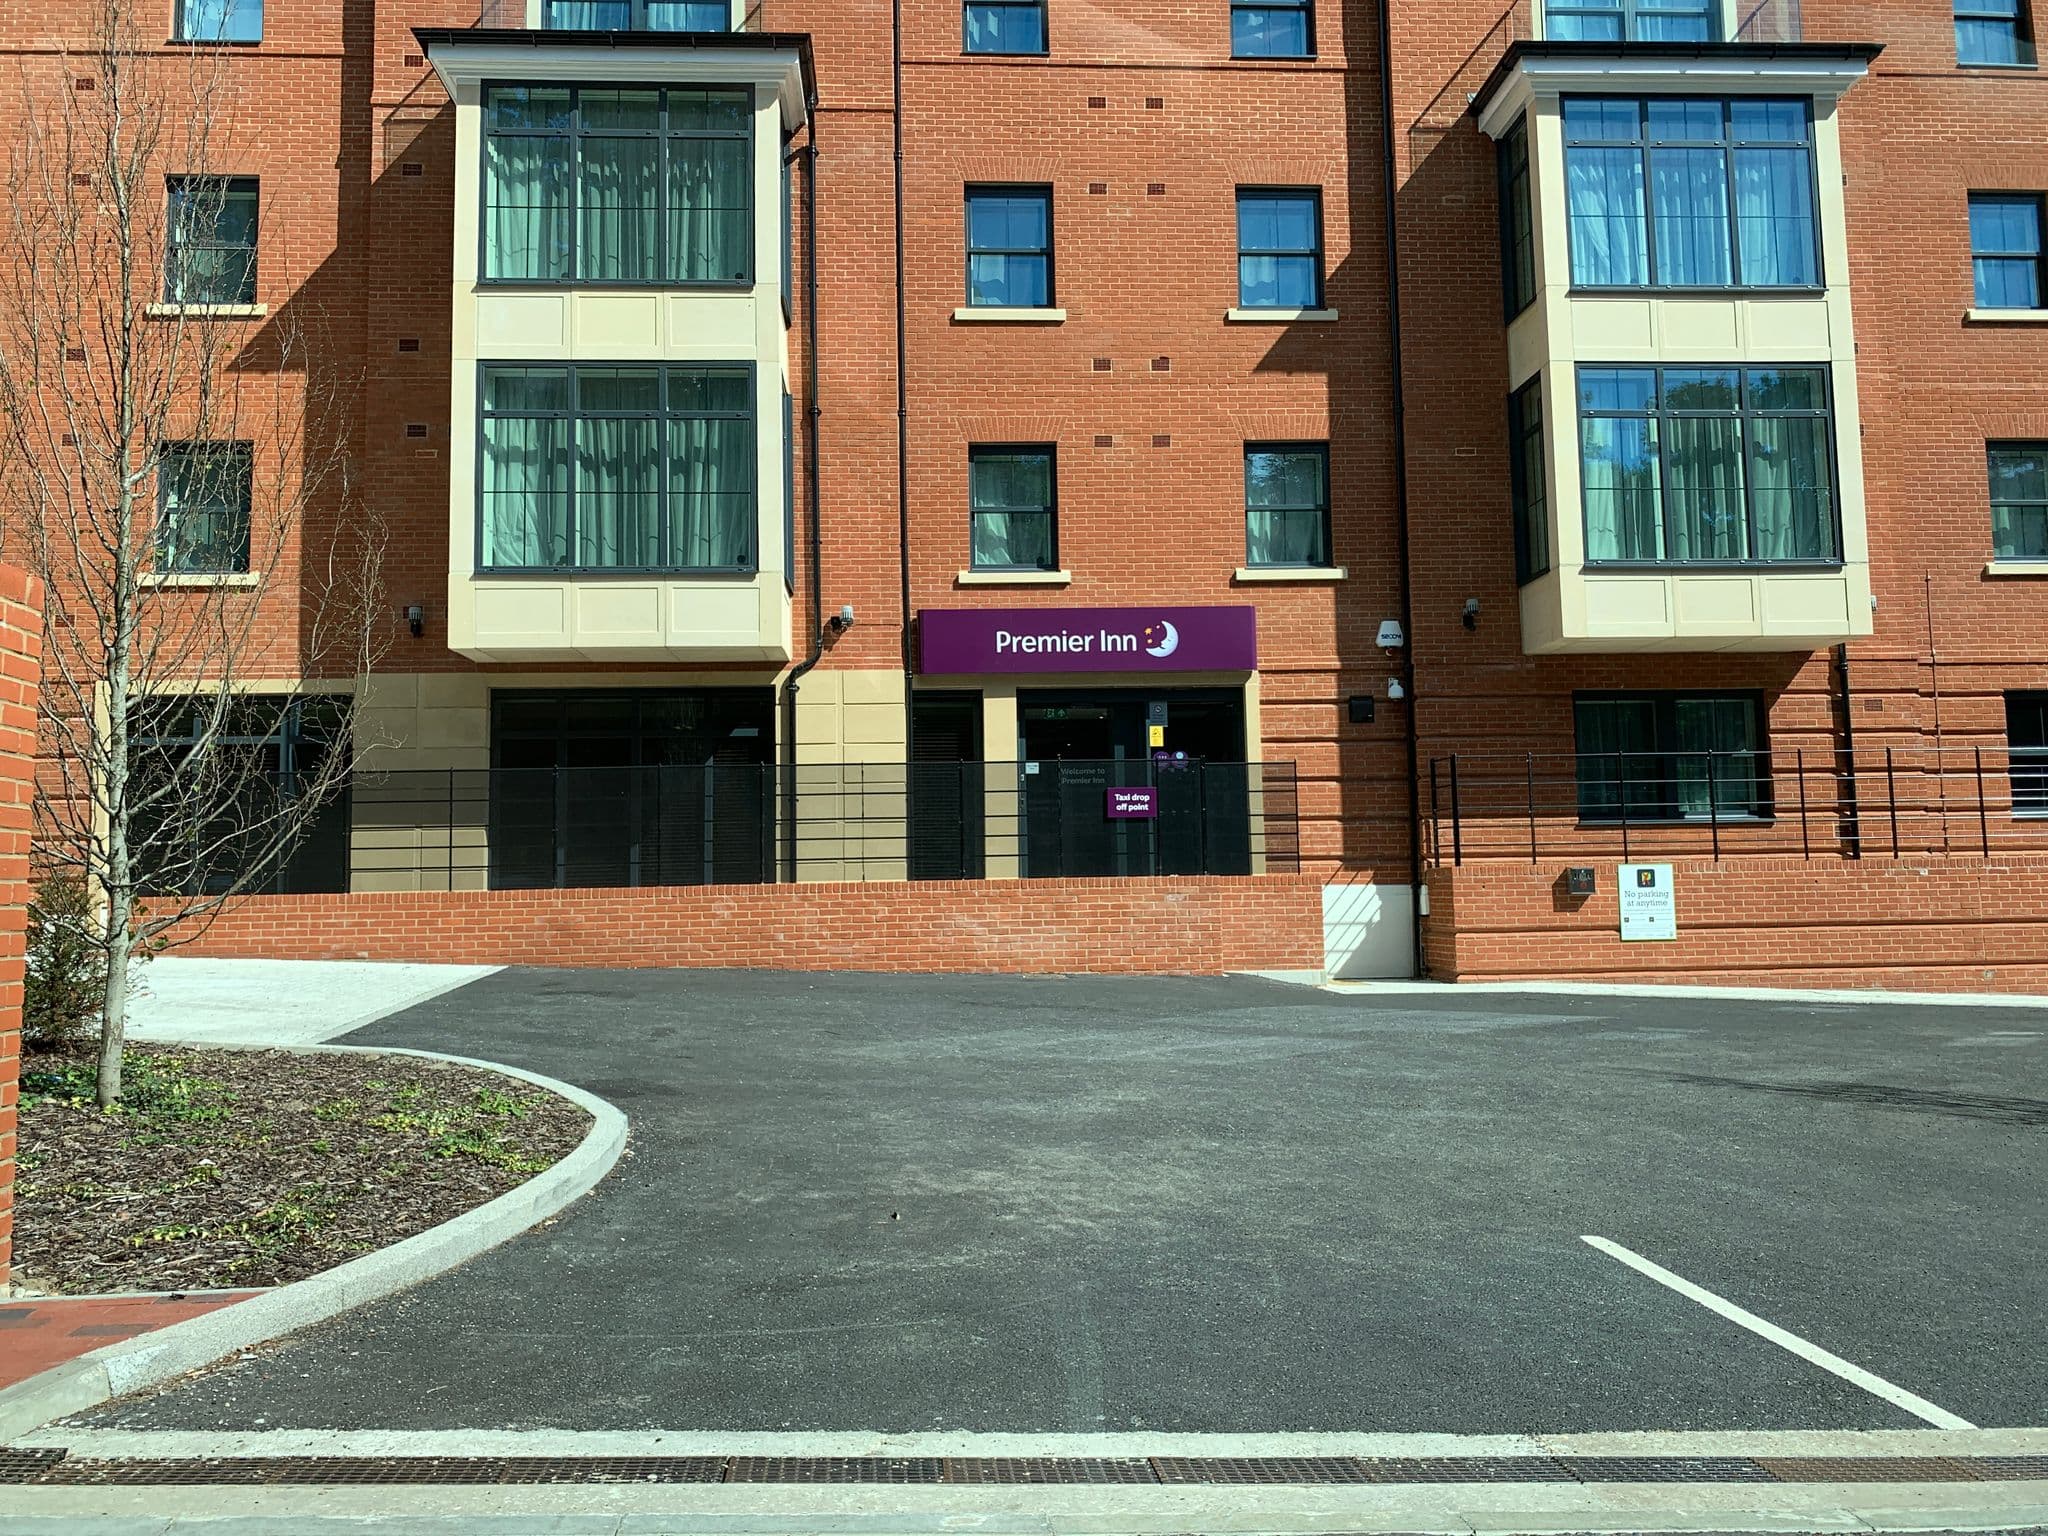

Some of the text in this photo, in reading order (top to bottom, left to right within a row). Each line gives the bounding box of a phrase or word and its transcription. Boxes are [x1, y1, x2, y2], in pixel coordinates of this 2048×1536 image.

[996, 630, 1137, 653] Premier Inn
[1061, 767, 1105, 775] Welcome to
[1061, 777, 1091, 785] Premier
[1114, 793, 1150, 803] Taxi drop
[1116, 803, 1149, 812] off point
[1624, 890, 1669, 899] No parking
[1636, 900, 1668, 908] anytime
